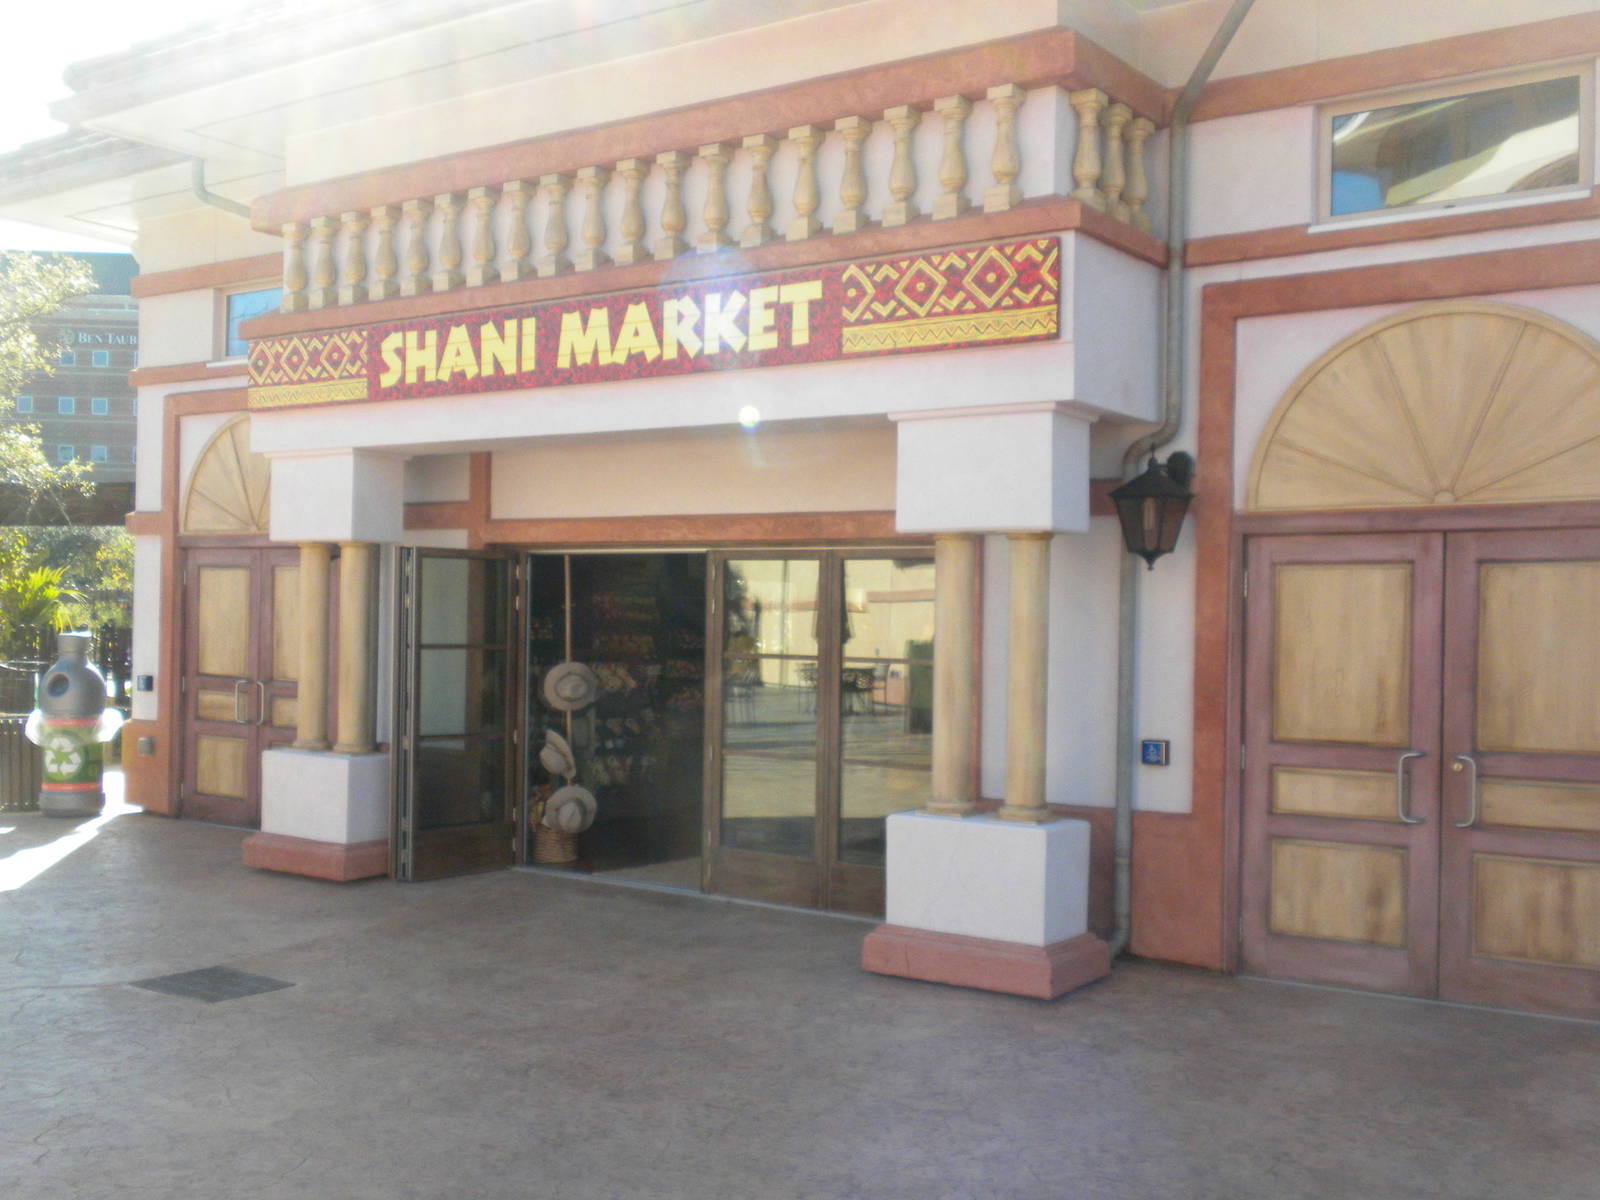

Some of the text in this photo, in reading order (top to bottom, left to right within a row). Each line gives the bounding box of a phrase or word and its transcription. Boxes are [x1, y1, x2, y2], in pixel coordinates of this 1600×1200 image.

[104, 332, 138, 345] TAUB
[379, 279, 823, 388] SHANI MARKET
